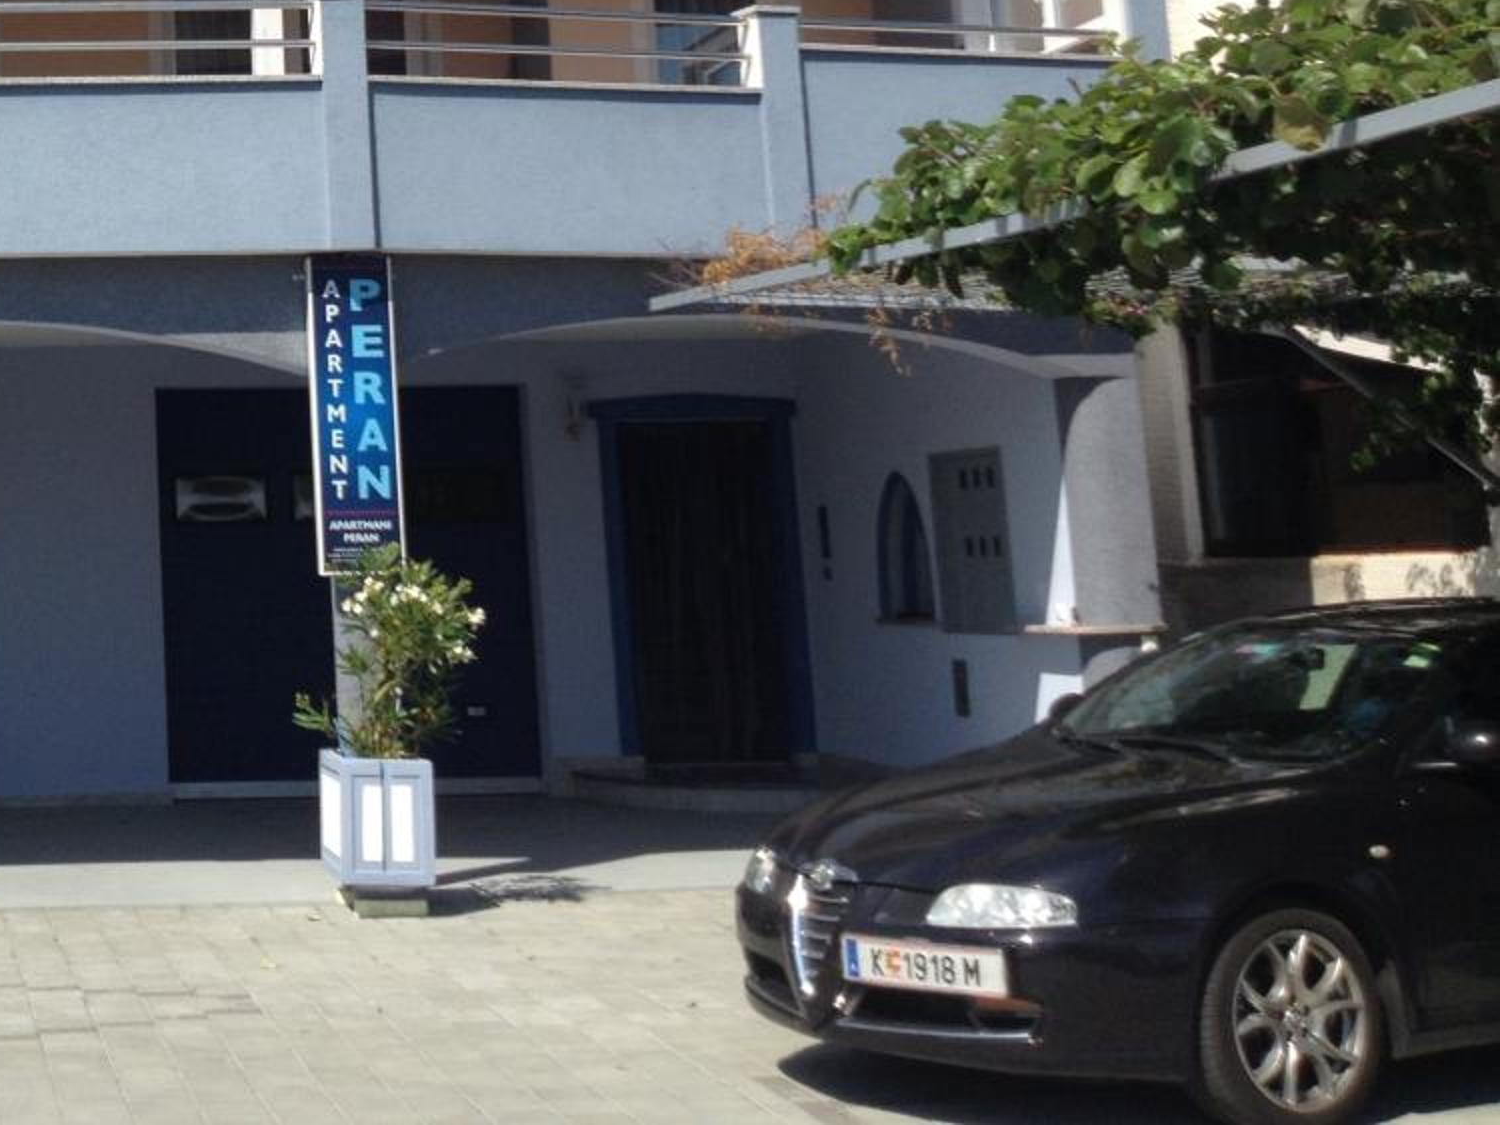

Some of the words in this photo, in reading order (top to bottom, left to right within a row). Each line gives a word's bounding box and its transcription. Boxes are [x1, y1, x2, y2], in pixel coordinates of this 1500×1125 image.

[322, 279, 349, 501] APARTMENT
[350, 278, 393, 501] PERAN
[903, 952, 956, 984] 1918
[963, 956, 981, 986] M
